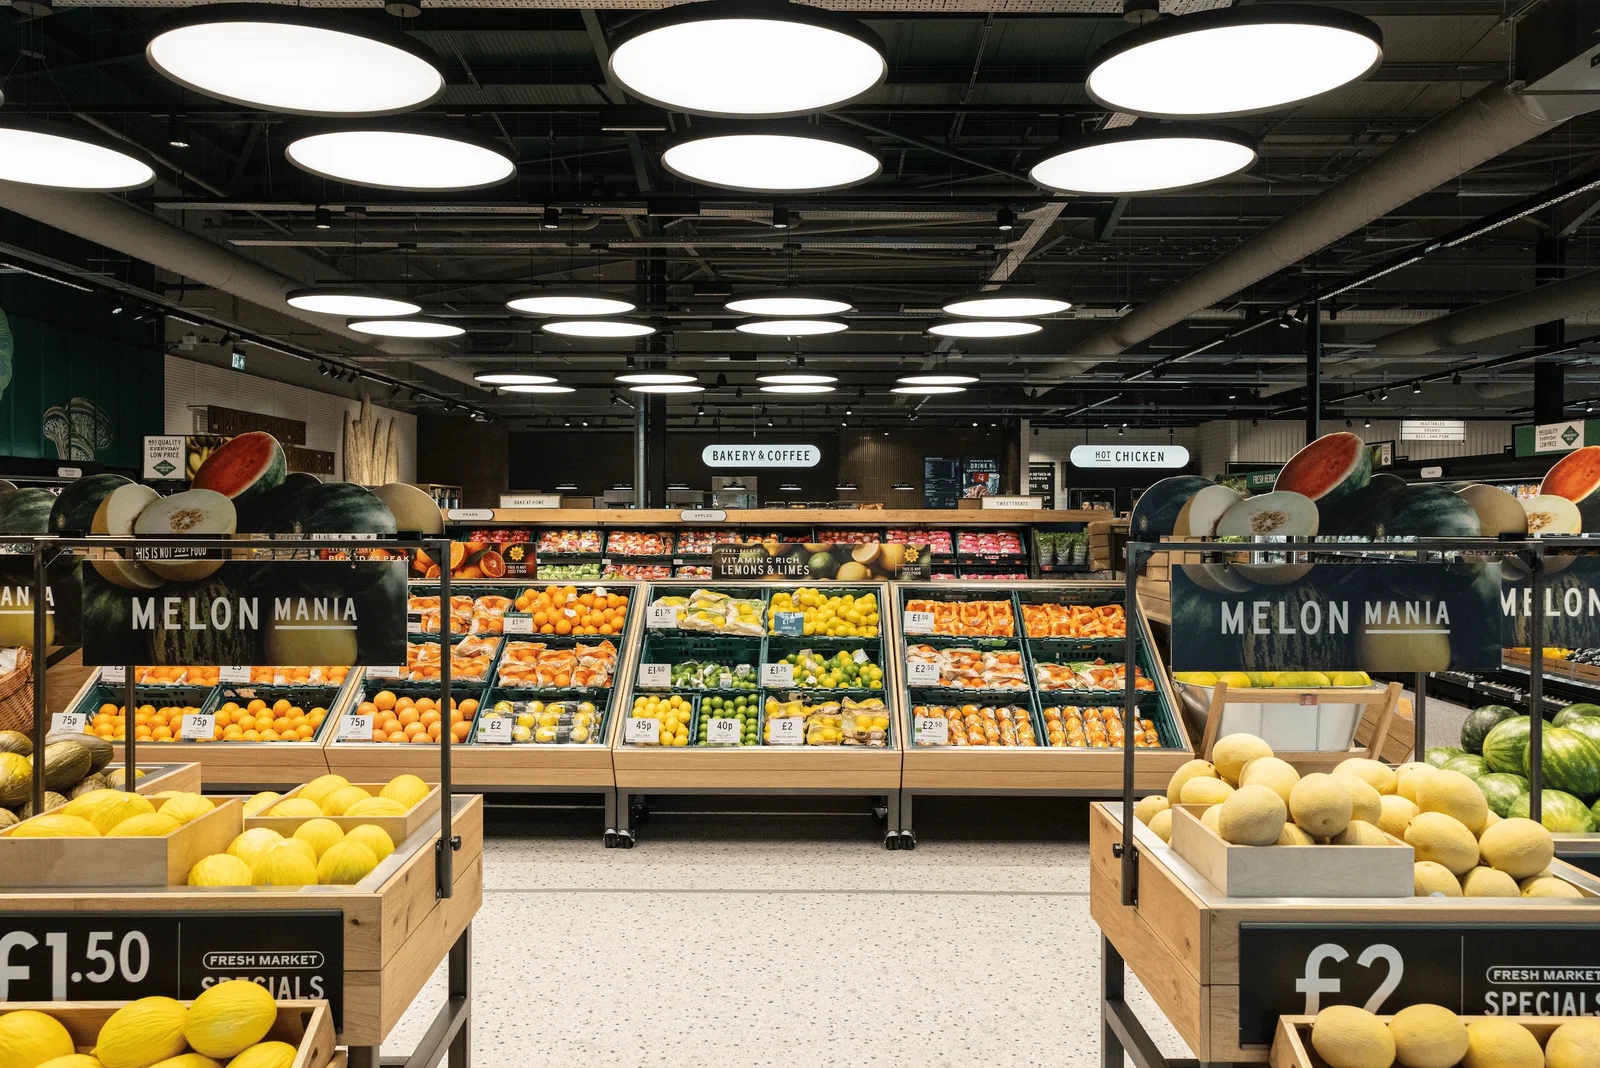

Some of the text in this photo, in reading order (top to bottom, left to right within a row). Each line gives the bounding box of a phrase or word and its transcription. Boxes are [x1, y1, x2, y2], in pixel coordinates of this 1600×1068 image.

[712, 450, 810, 461] BAKERY & COFFEE
[1096, 451, 1164, 462] HOT CHICKEN
[1252, 474, 1264, 484] FRESH
[136, 548, 149, 560] HIS
[152, 548, 158, 559] IS
[160, 548, 172, 558] NOT
[721, 565, 810, 575] LEMONS & LIMES
[0, 586, 54, 606] ANA
[132, 597, 357, 630] MELON MANIA
[1221, 601, 1450, 634] MELON MANIA
[62, 716, 77, 726] 75p
[193, 717, 207, 727] 75p
[351, 718, 365, 728] 75p
[490, 721, 501, 729] £2
[636, 721, 652, 731] 45p
[782, 722, 793, 730] £2
[923, 721, 942, 729] £2.50
[717, 721, 732, 732] 40p
[210, 955, 317, 966] FRESH MARKET
[0, 931, 150, 1001] £1.50
[1296, 943, 1404, 1014] £2
[1494, 970, 1600, 980] FRESH MARKET
